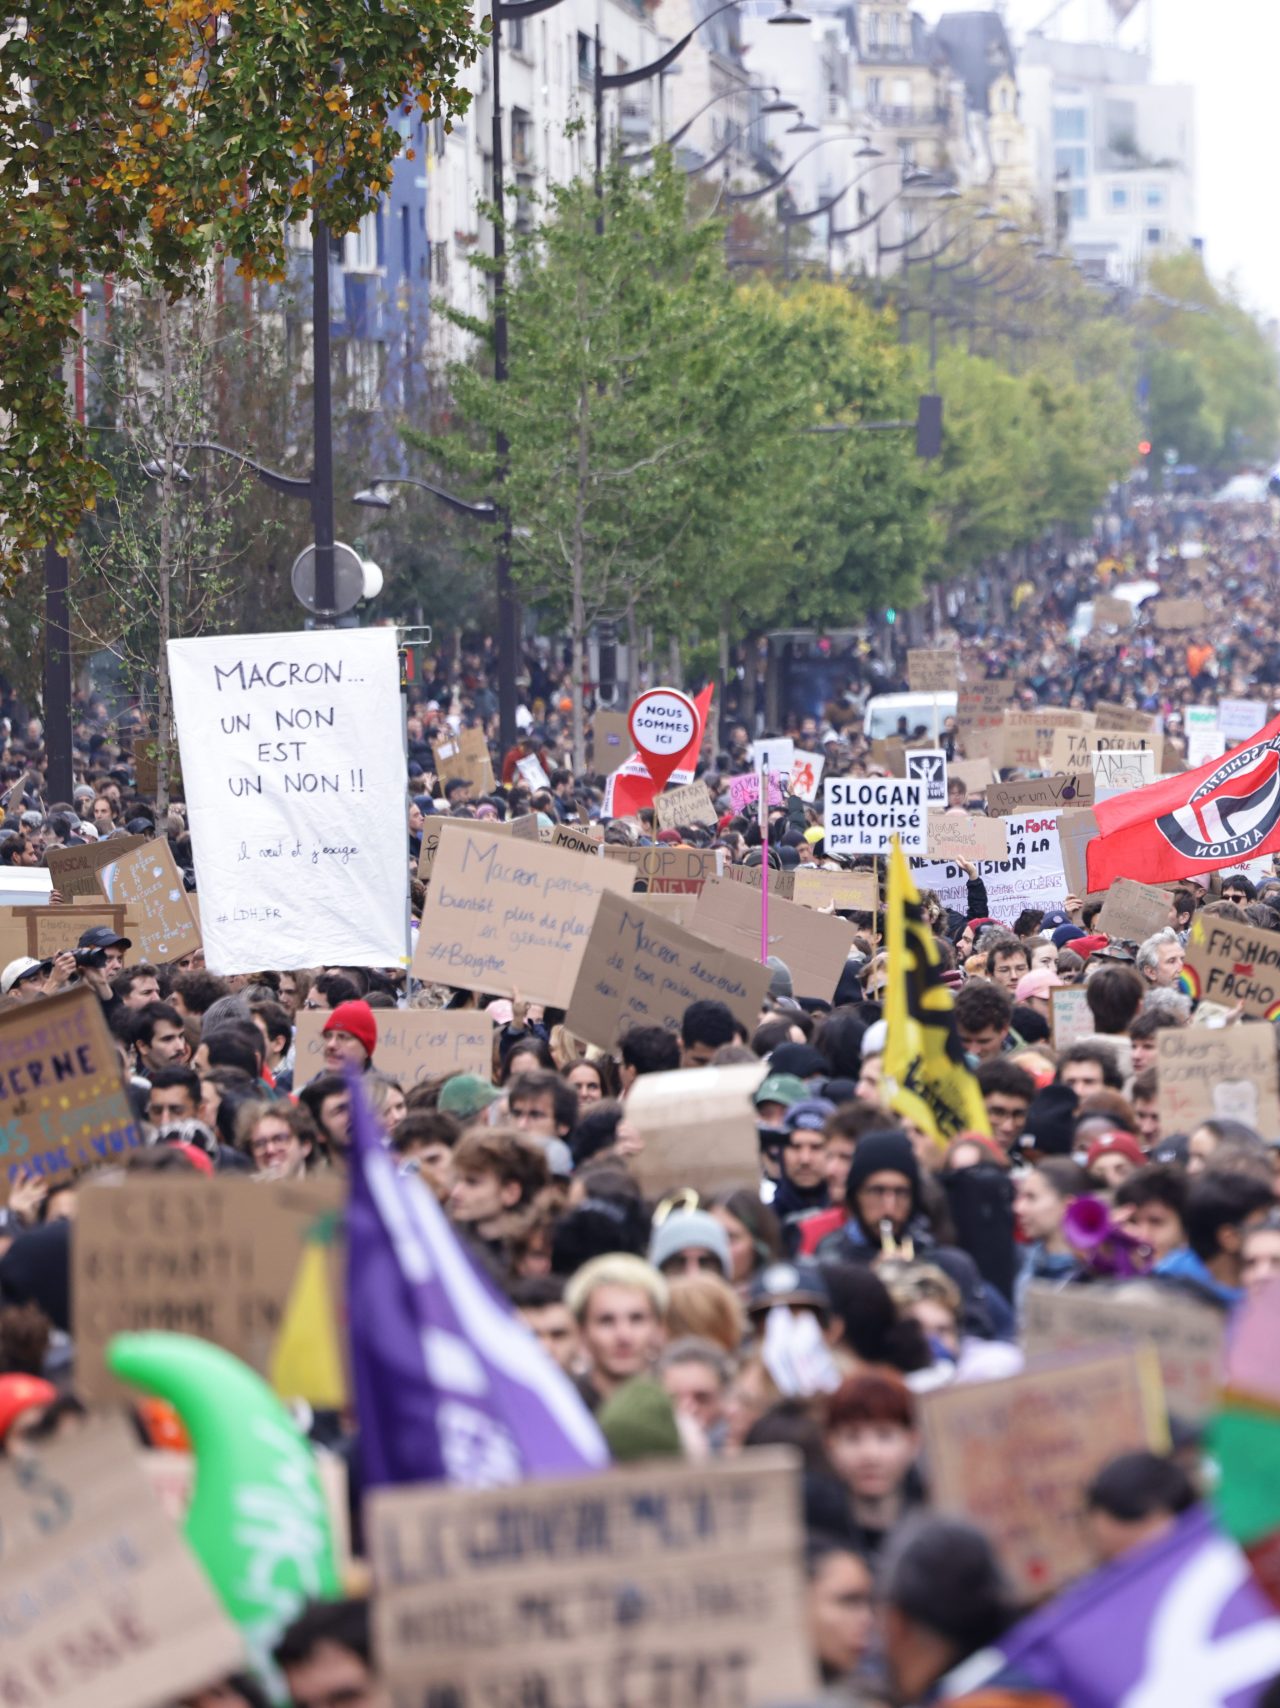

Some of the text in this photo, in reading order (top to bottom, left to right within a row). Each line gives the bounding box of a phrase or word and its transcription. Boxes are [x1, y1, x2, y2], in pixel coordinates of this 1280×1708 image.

[221, 707, 334, 734] UN NON
[646, 705, 683, 718] NOUS
[636, 718, 689, 733] SOMMES
[656, 734, 673, 744] ICI
[1067, 735, 1088, 751] TA
[258, 742, 307, 762] EST
[229, 775, 262, 796] UN
[285, 773, 339, 793] NON
[831, 785, 920, 805] SLOGAN
[831, 808, 920, 828] autorisé
[1010, 819, 1060, 836] LA FORC
[556, 833, 599, 855] MOINS
[831, 834, 854, 848] par
[860, 831, 872, 844] la
[1031, 838, 1050, 853] LA
[461, 837, 541, 885] Macron
[946, 856, 1026, 879] DIISION
[504, 906, 536, 927] plus
[539, 913, 557, 930] de
[618, 911, 680, 967] Macron
[607, 952, 625, 973] de
[634, 964, 655, 987] ton
[1205, 967, 1275, 1004] FACHO
[455, 1028, 486, 1060] pas
